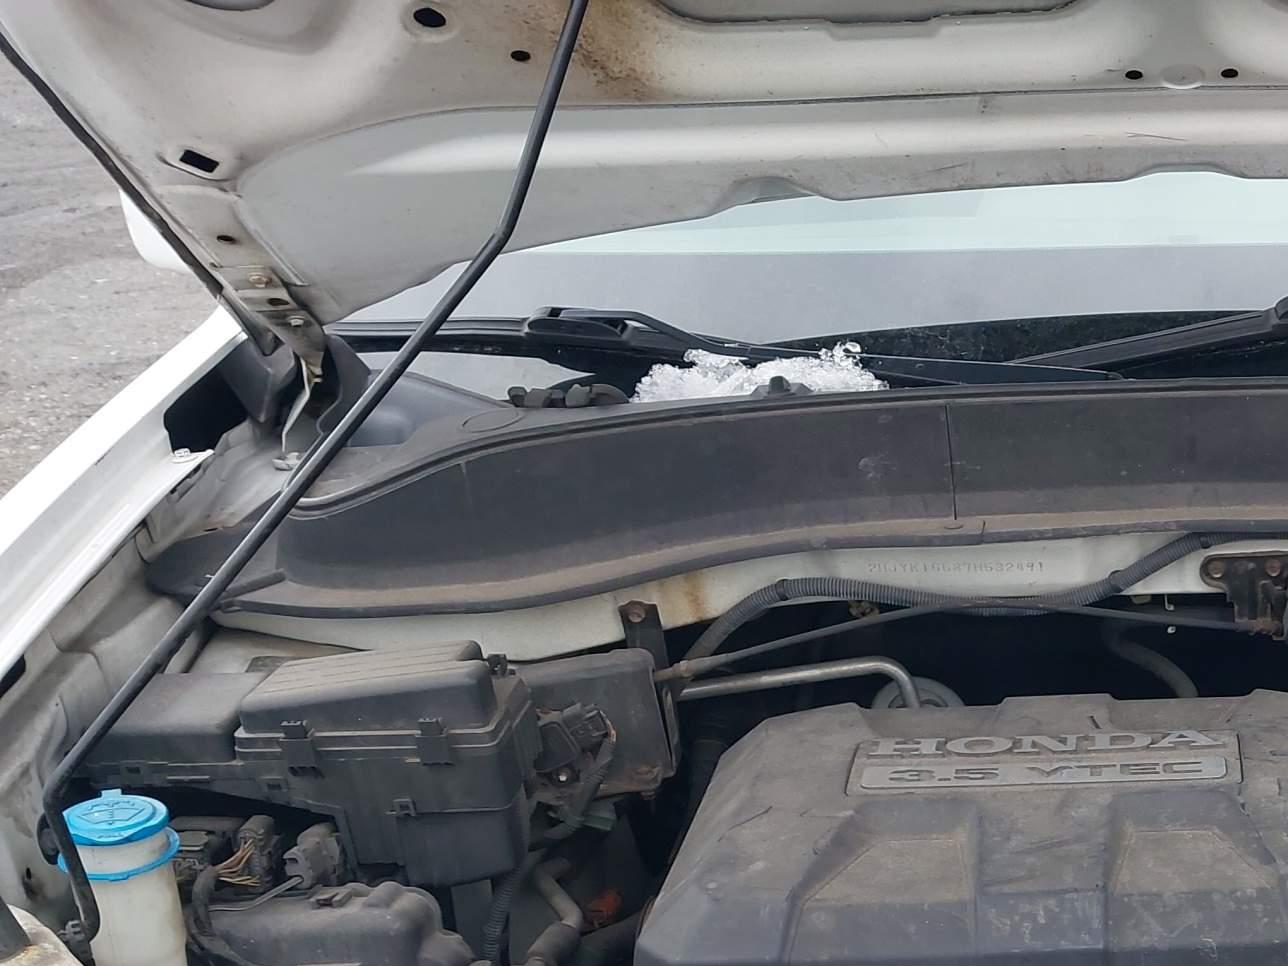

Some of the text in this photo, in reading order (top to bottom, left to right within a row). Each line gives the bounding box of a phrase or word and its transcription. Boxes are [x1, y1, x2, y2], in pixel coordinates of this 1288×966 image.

[868, 730, 1226, 757] HONDA
[888, 761, 1204, 782] 3.5 VTEC
